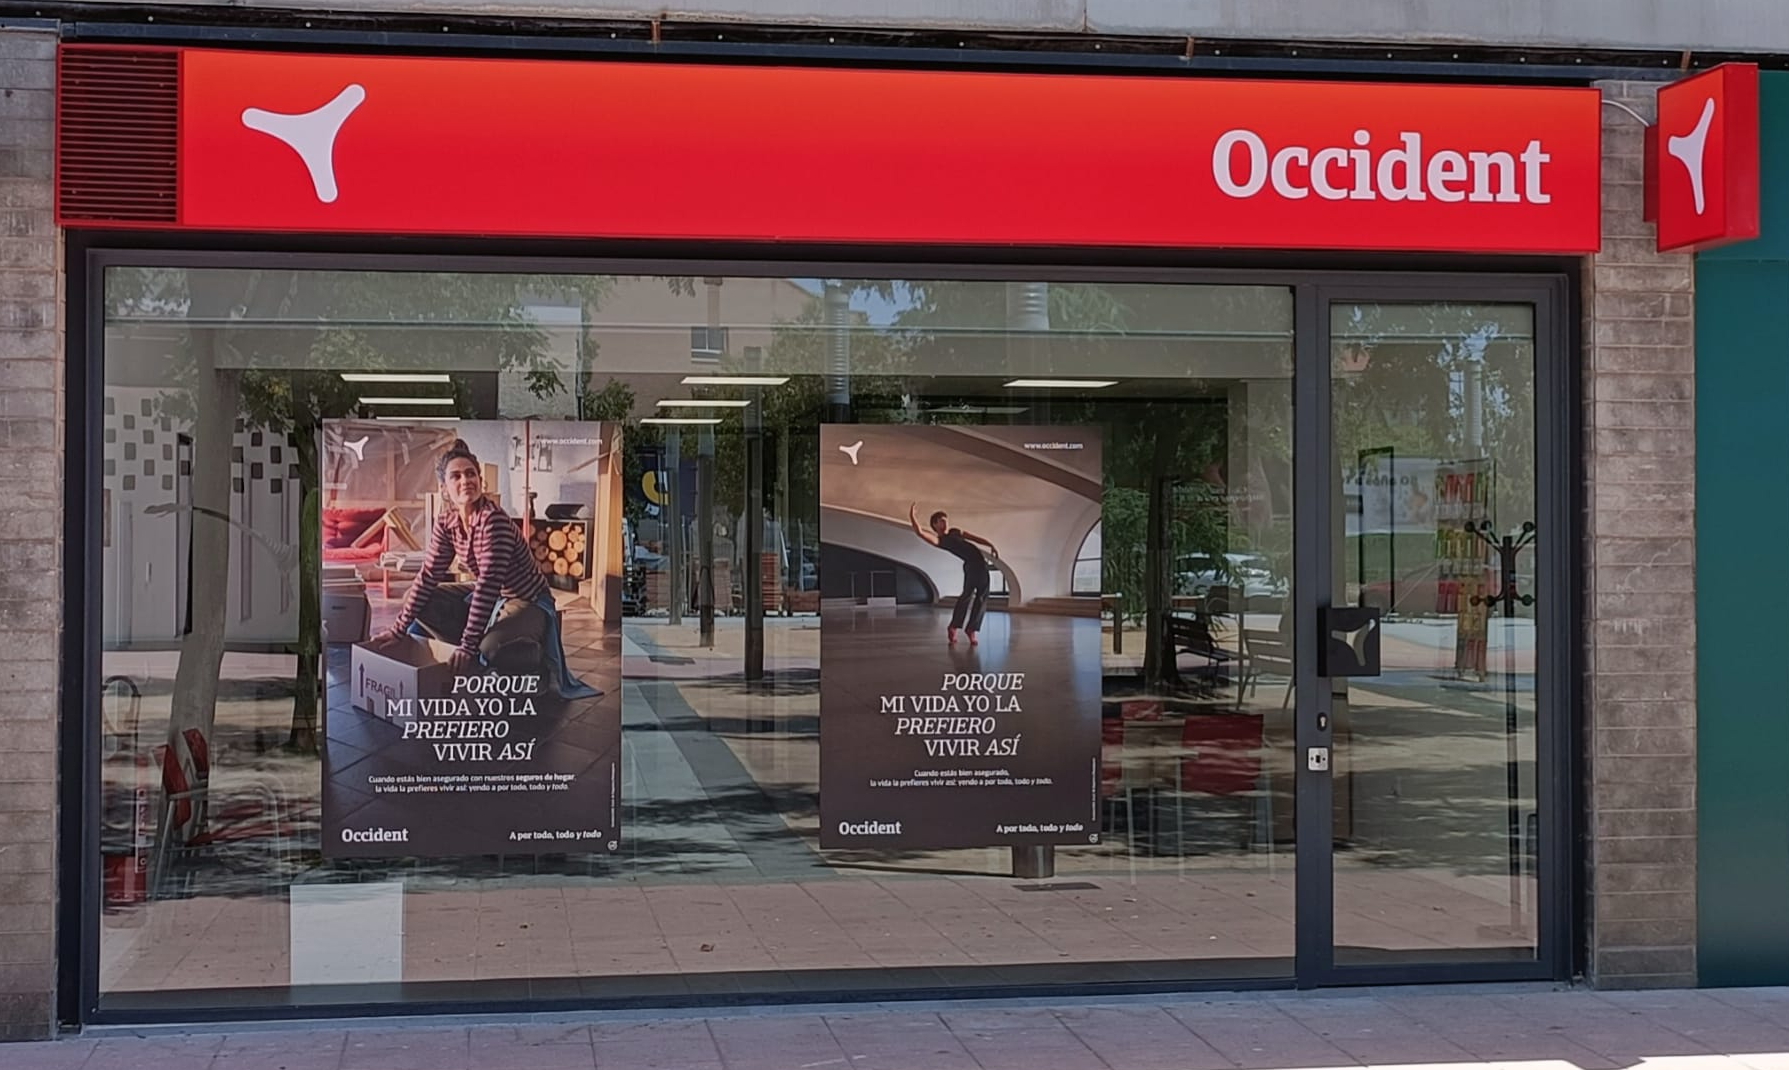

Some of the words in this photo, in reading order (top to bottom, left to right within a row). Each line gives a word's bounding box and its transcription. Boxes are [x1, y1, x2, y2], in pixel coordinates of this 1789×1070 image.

[1212, 128, 1551, 204] Occident
[452, 675, 540, 696] PORQUE
[941, 674, 1025, 693] PORQUE
[386, 699, 413, 718] MI
[418, 698, 472, 717] VIDA
[476, 698, 504, 716] YO
[508, 698, 537, 716] LA
[880, 696, 905, 714] MI
[910, 696, 960, 713] VIDA
[964, 696, 990, 713] YO
[994, 696, 1022, 712] LA
[402, 720, 510, 740] PREFIERO
[894, 717, 996, 735] PREFIERO
[434, 743, 493, 762] VIVIR
[497, 738, 536, 760] ASÍ
[924, 740, 981, 756] VIVIR
[984, 734, 1022, 756] ASÍ
[368, 776, 396, 784] Cuando
[432, 775, 469, 784] asegurado
[516, 774, 543, 782] seguros
[900, 779, 929, 787] prefieres
[406, 784, 438, 793] prefieres
[468, 784, 490, 792] yendo
[341, 828, 409, 843] Occident
[509, 831, 516, 840] A
[517, 832, 532, 841] por
[533, 830, 555, 840] todo,
[556, 830, 575, 839] todo
[576, 832, 582, 840] y
[583, 829, 602, 838] todo
[838, 820, 902, 836] Occident
[996, 824, 1003, 833] A
[1004, 825, 1018, 834] por
[1040, 823, 1058, 832] todo
[1059, 825, 1065, 833] y
[1066, 823, 1084, 832] todo
